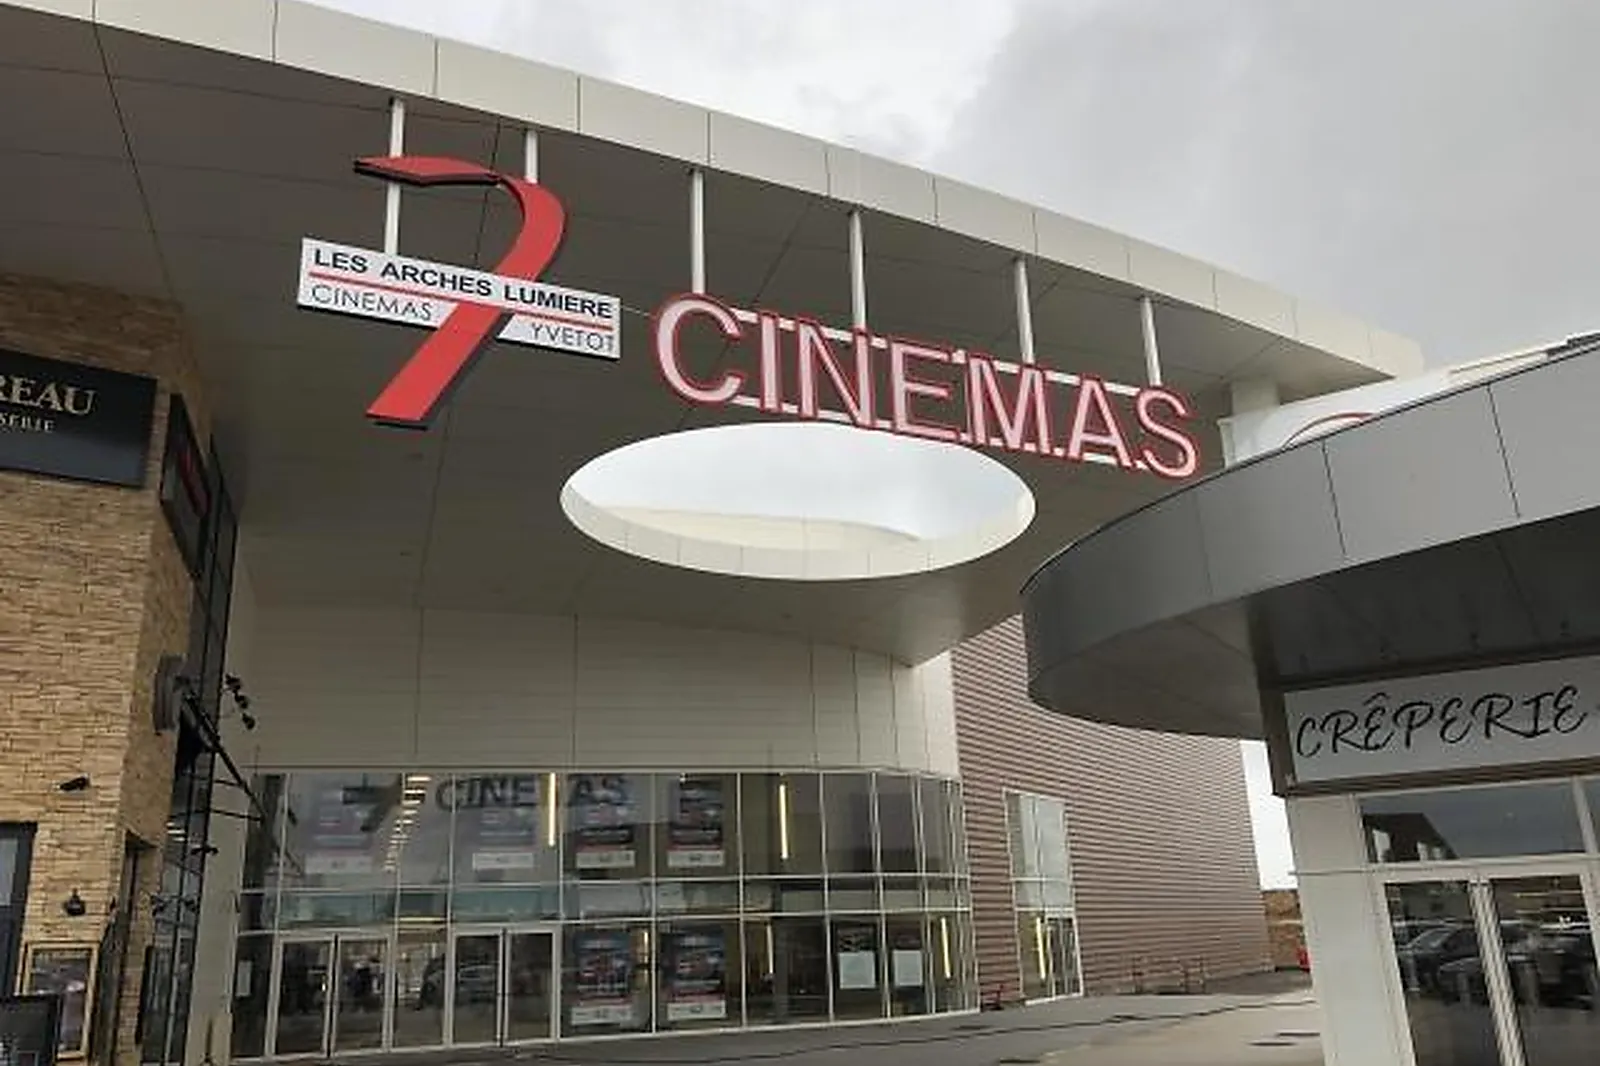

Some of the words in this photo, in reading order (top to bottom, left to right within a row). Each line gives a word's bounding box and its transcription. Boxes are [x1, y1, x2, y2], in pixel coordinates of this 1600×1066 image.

[311, 283, 434, 321] CINEMAS
[530, 322, 614, 352] YVETOT
[314, 249, 367, 273] LES
[380, 262, 492, 297] ARCHES
[503, 284, 614, 319] LUMIERE
[653, 292, 1198, 479] CINEMAS
[1296, 685, 1588, 758] CRÊPERIE
